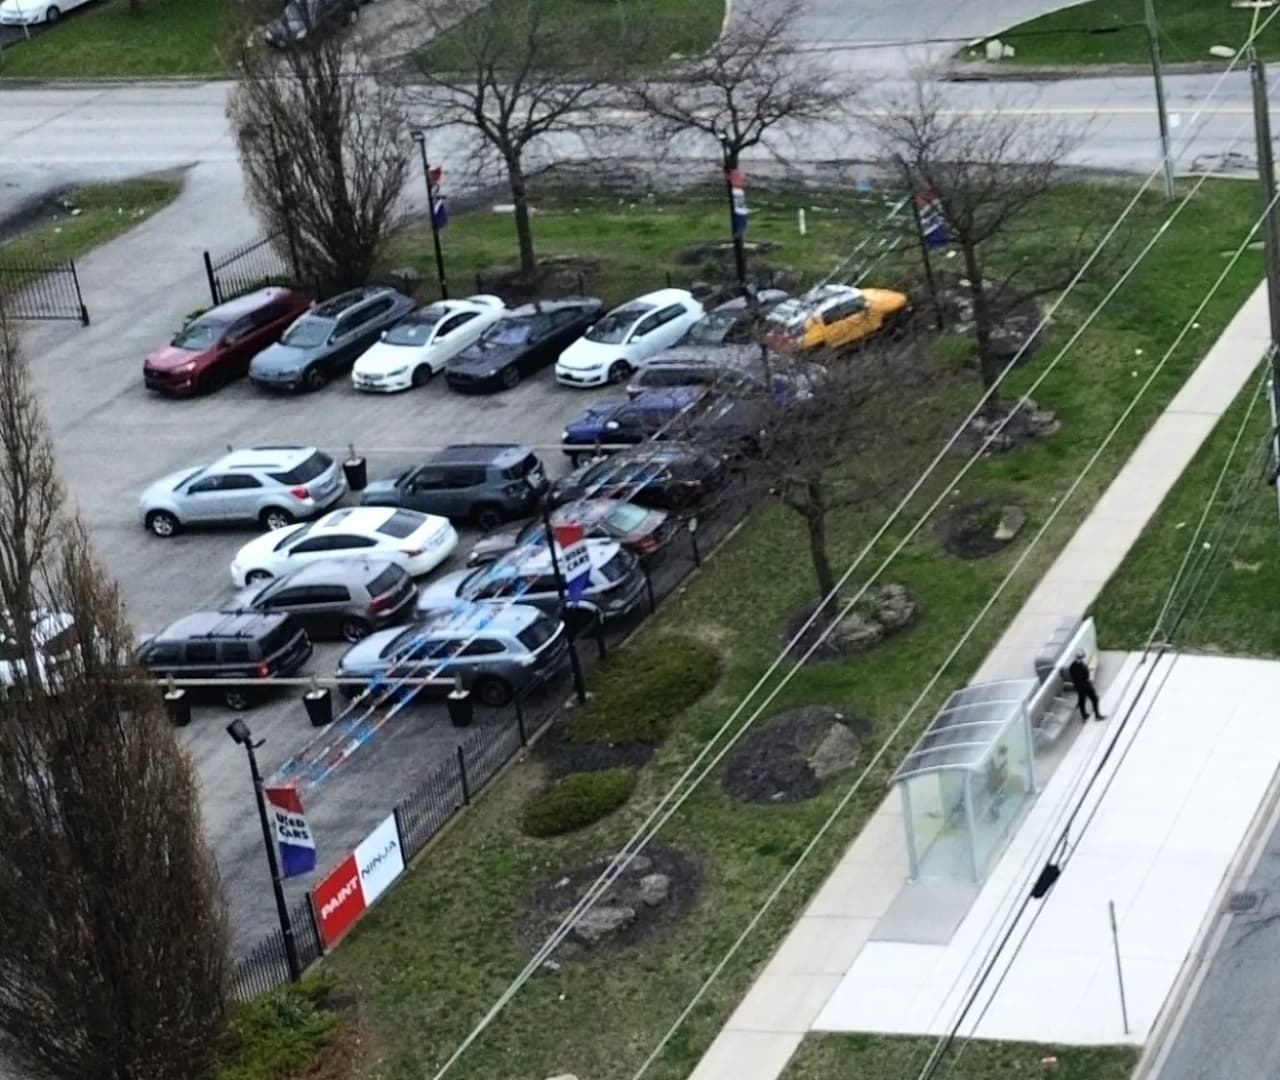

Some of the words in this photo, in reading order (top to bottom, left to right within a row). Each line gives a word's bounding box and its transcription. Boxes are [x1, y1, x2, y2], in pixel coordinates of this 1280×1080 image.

[276, 813, 305, 827] USED
[278, 826, 309, 840] CARS
[320, 875, 359, 920] PAINT
[361, 840, 397, 879] NINJA
